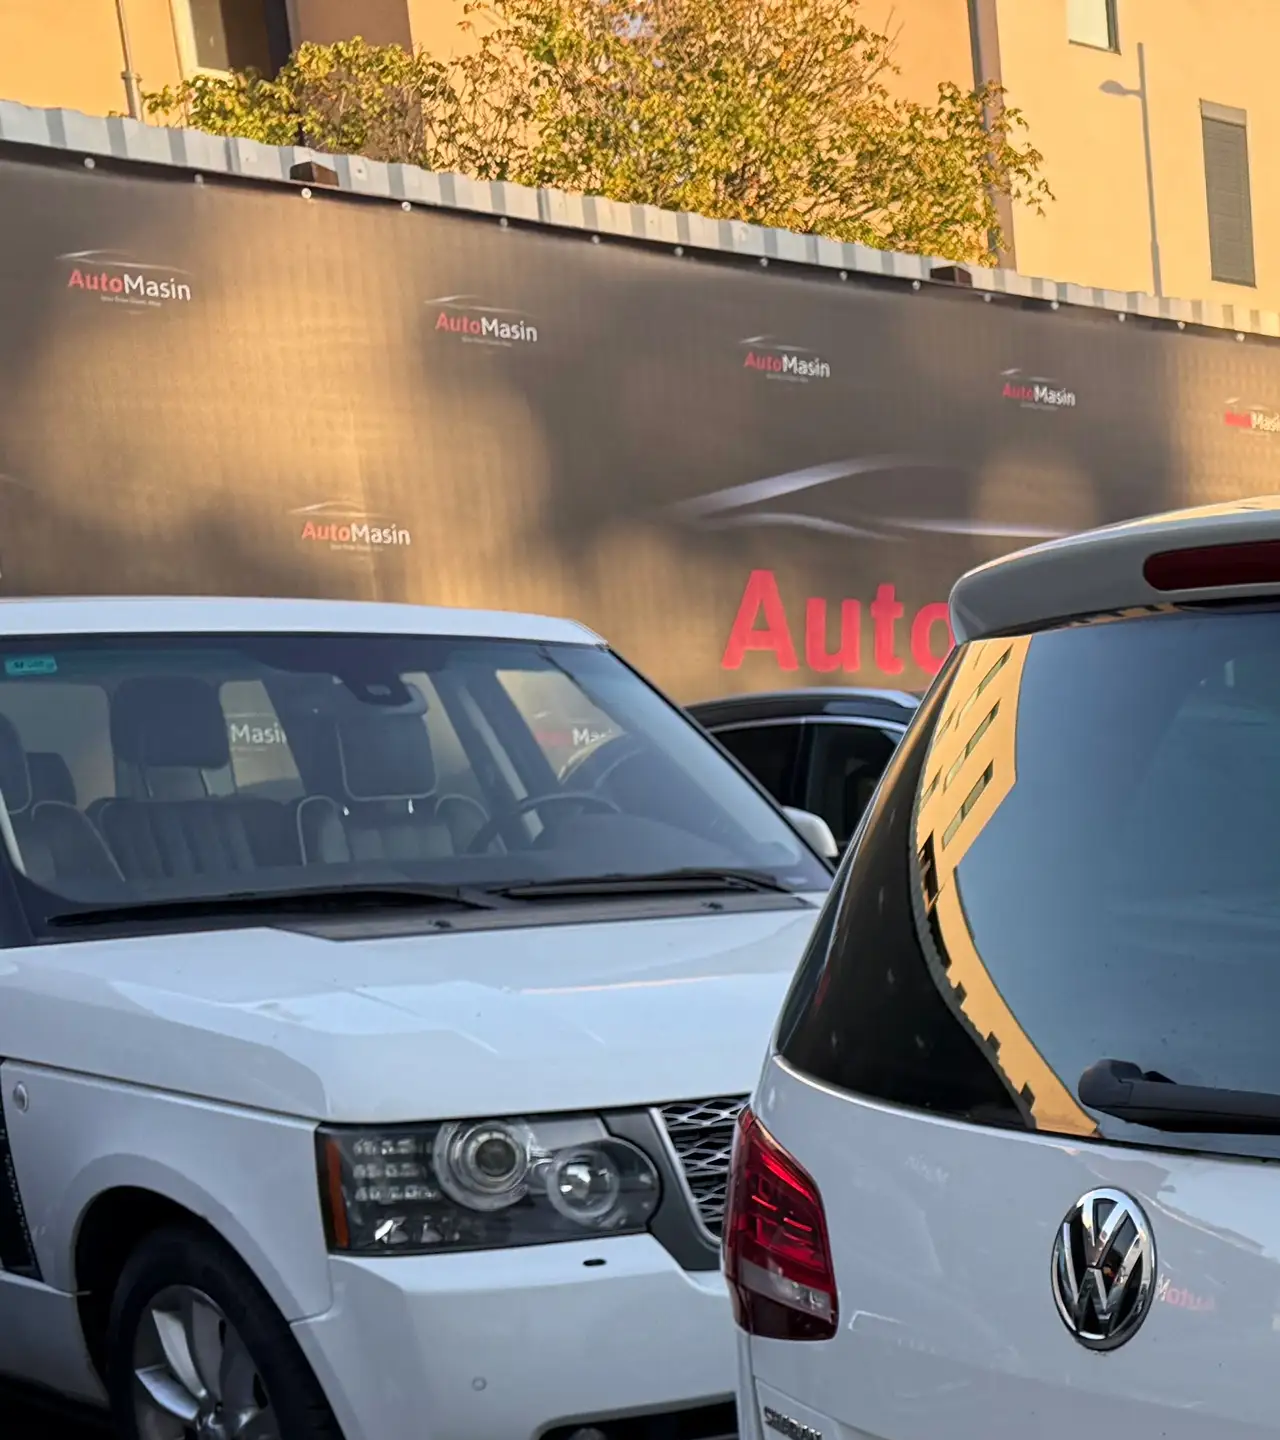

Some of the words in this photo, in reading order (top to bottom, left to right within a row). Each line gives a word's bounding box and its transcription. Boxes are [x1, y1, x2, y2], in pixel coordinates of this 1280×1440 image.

[67, 267, 191, 302] AutoMasin
[434, 311, 539, 343] AutoMasin
[742, 351, 832, 379] AutoMasin
[301, 519, 412, 546] AutoMasin
